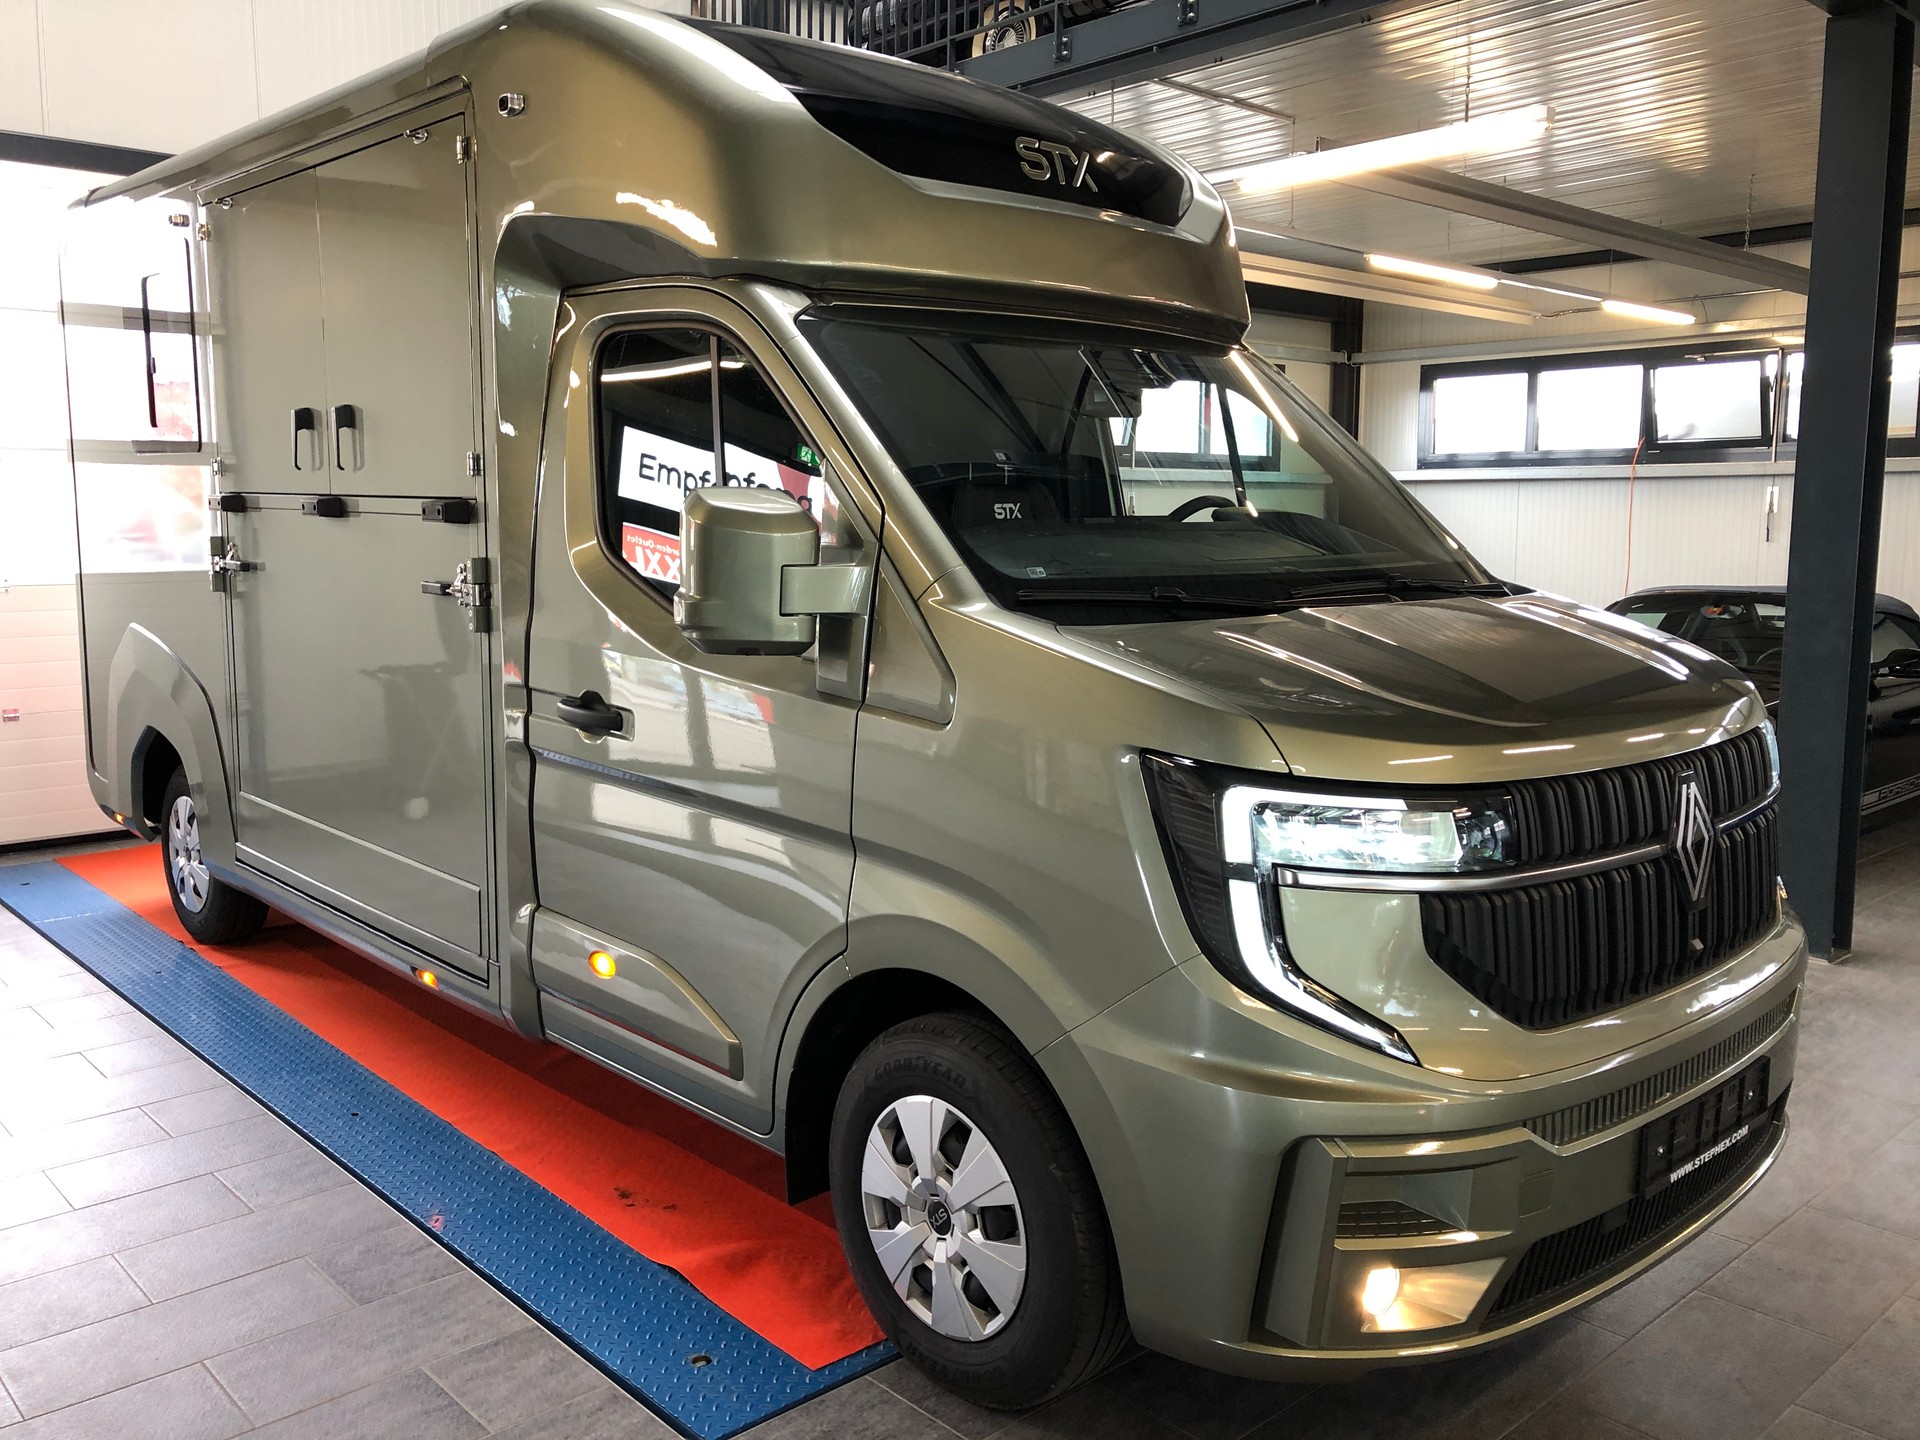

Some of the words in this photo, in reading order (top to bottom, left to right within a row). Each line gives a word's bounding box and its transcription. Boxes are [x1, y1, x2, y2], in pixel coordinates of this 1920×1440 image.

[1015, 136, 1099, 193] STX
[993, 503, 1022, 519] STX
[1669, 1124, 1749, 1184] WWW.STEPHEX.COM
[930, 1208, 947, 1229] STX
